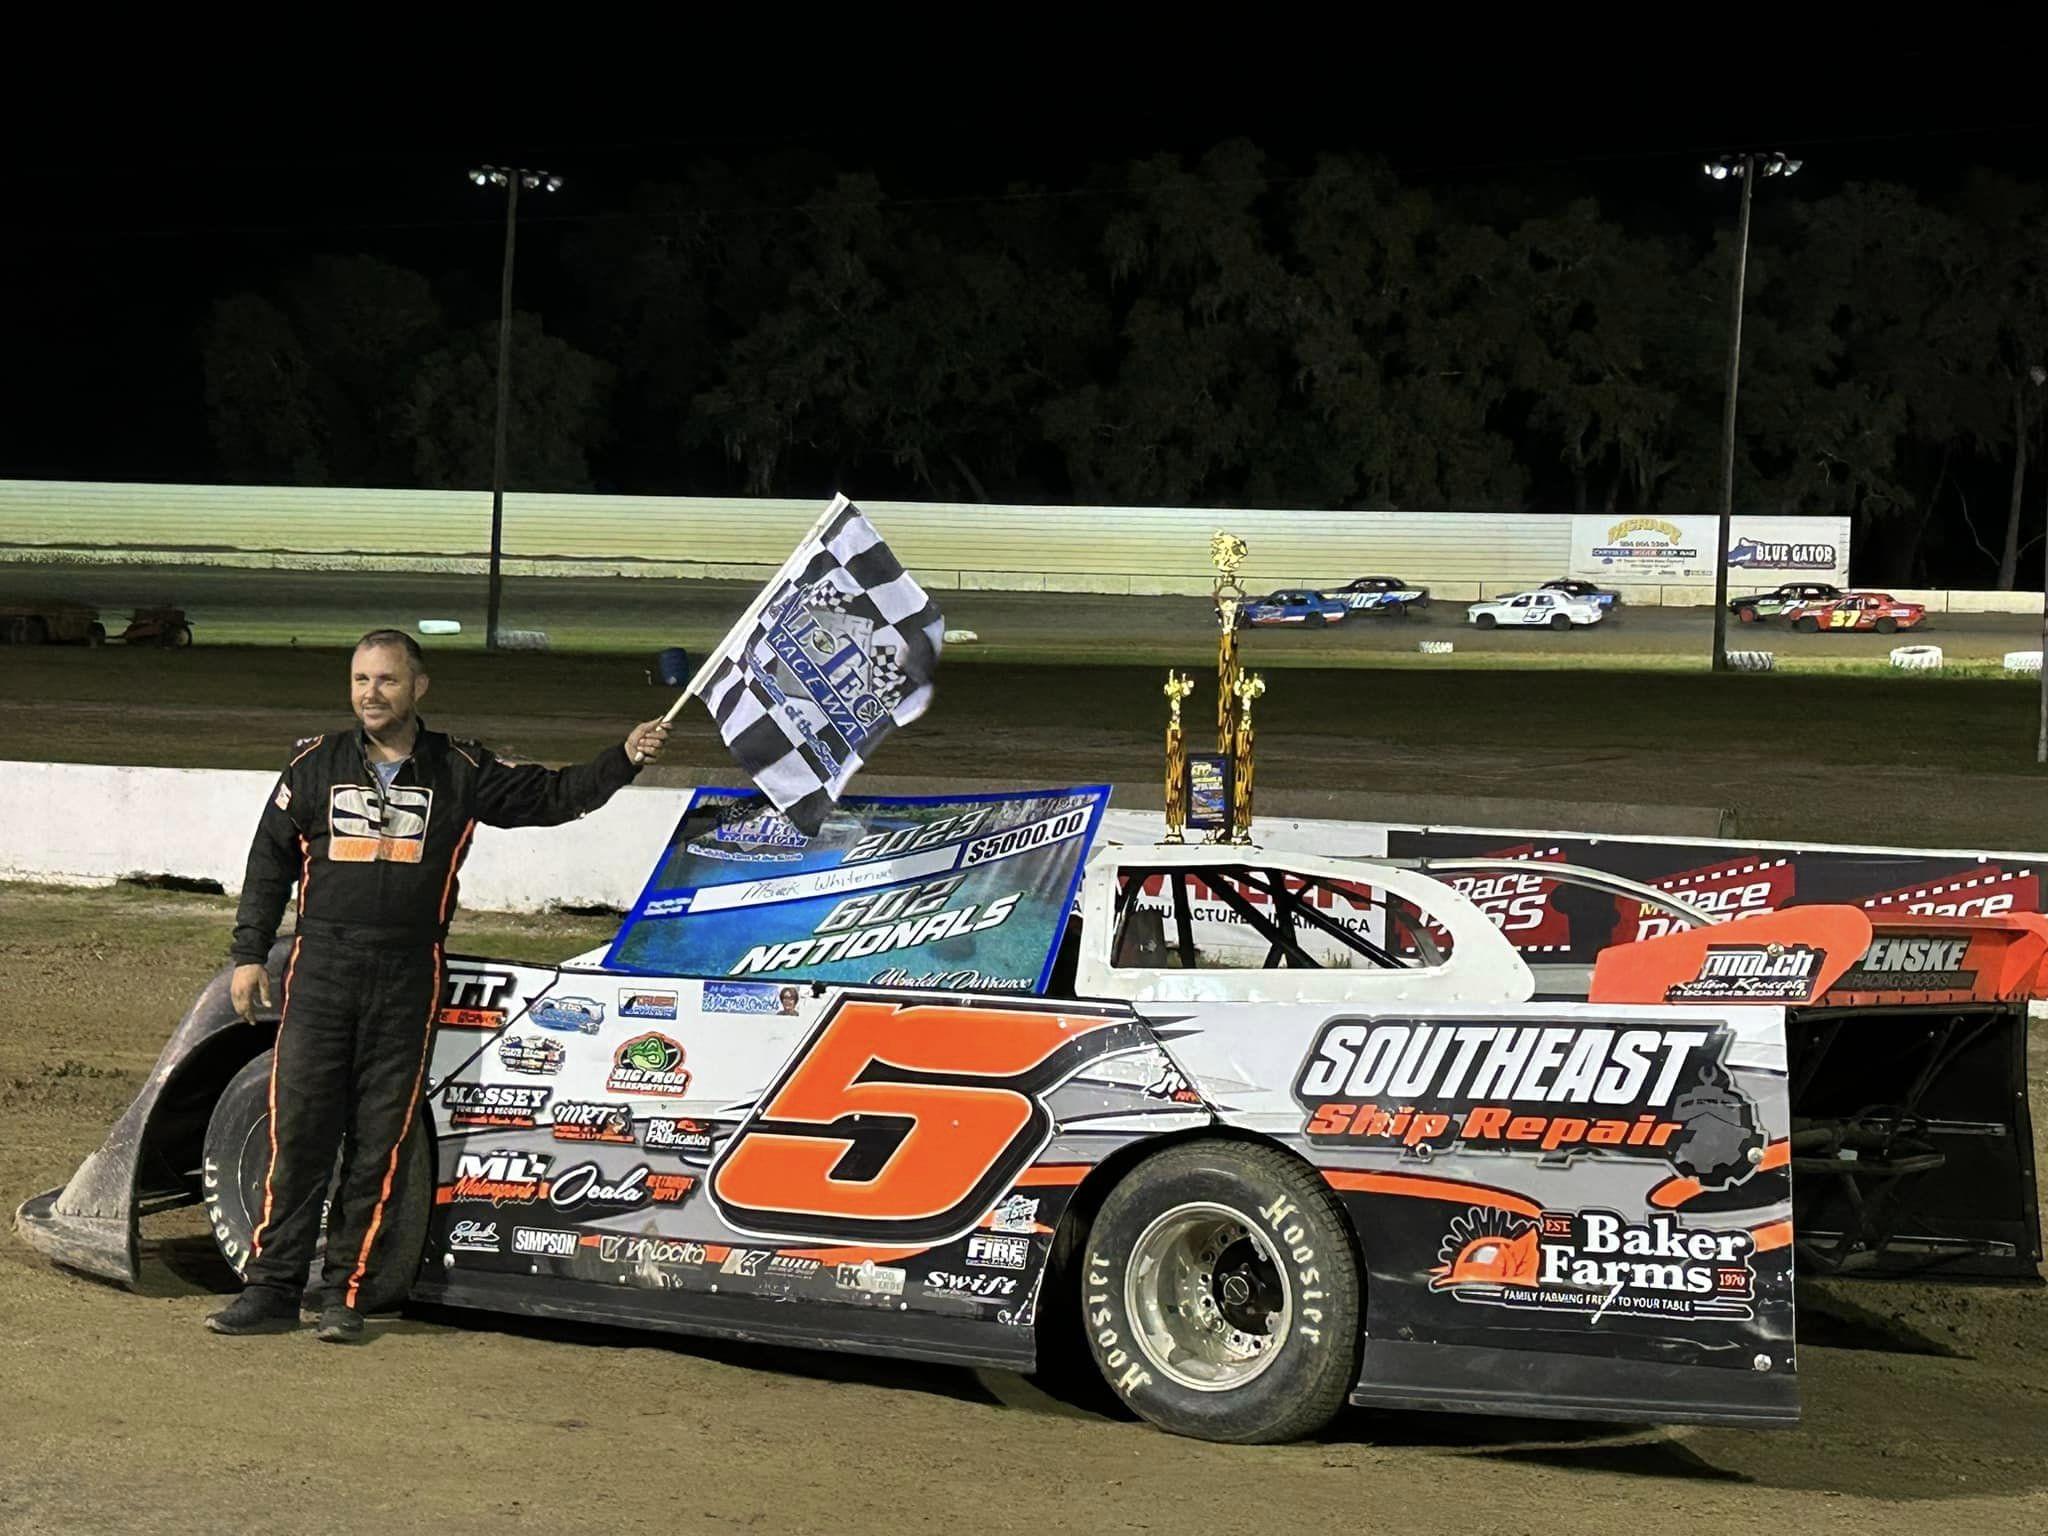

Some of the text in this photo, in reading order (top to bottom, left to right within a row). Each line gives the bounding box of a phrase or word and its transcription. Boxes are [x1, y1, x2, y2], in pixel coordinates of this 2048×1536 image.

[1755, 545, 1833, 562] BLUE GATOR
[1830, 610, 1861, 627] 37
[841, 807, 993, 862] 2023
[968, 811, 1084, 864] $5000.00
[812, 874, 967, 934] 602
[728, 892, 1024, 974] NATIONALS
[612, 1068, 641, 1081] BIG
[1301, 1025, 1708, 1107] SOUTHEAST
[650, 1119, 675, 1131] PRO
[712, 998, 1120, 1224] 5
[1306, 1103, 1682, 1150] Ship Repair
[551, 1165, 649, 1205] Ocala
[515, 1230, 577, 1255] SIMPSON
[967, 1238, 1024, 1262] FIRE
[1582, 1214, 1745, 1261] Baker
[838, 1267, 861, 1286] FK
[924, 1271, 1017, 1295] Swift
[1540, 1244, 1712, 1293] Farms
[1720, 1272, 1746, 1287] 1970
[1504, 1289, 1538, 1302] FAMILY
[1540, 1291, 1583, 1304] FARMING
[1618, 1296, 1631, 1307] TO
[1633, 1297, 1660, 1309] YOUR
[1662, 1299, 1690, 1311] TABLE
